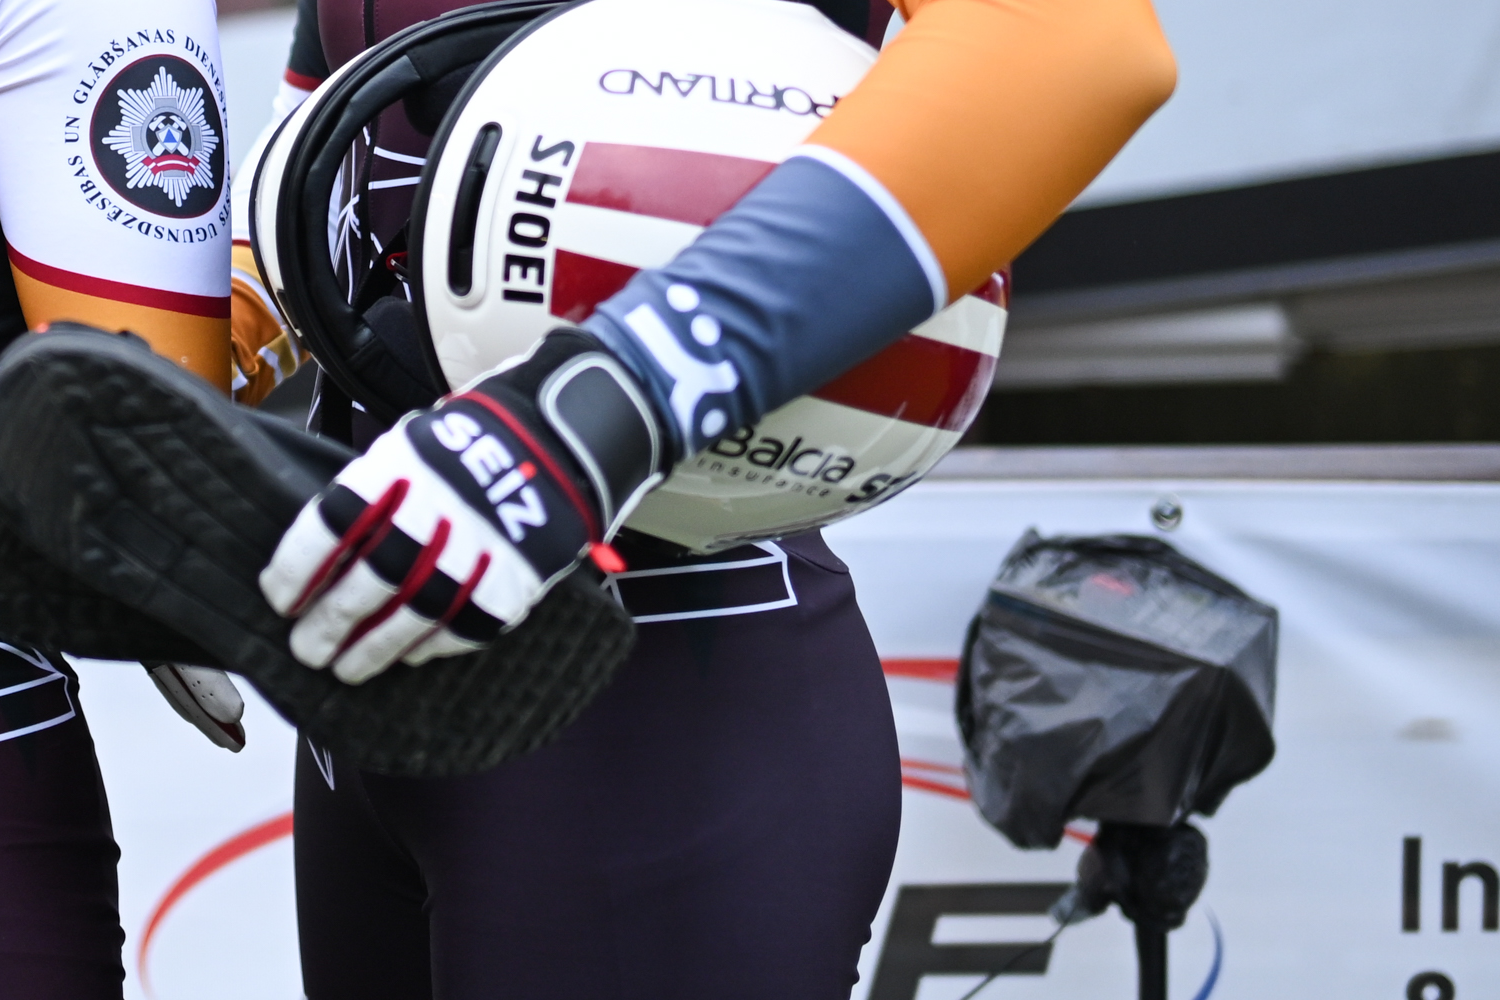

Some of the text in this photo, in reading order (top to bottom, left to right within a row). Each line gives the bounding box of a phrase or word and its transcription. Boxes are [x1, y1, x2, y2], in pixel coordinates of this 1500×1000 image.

[72, 28, 176, 105] GLĀBŠANAS
[64, 115, 81, 144] UN
[503, 134, 575, 304] SHOEI
